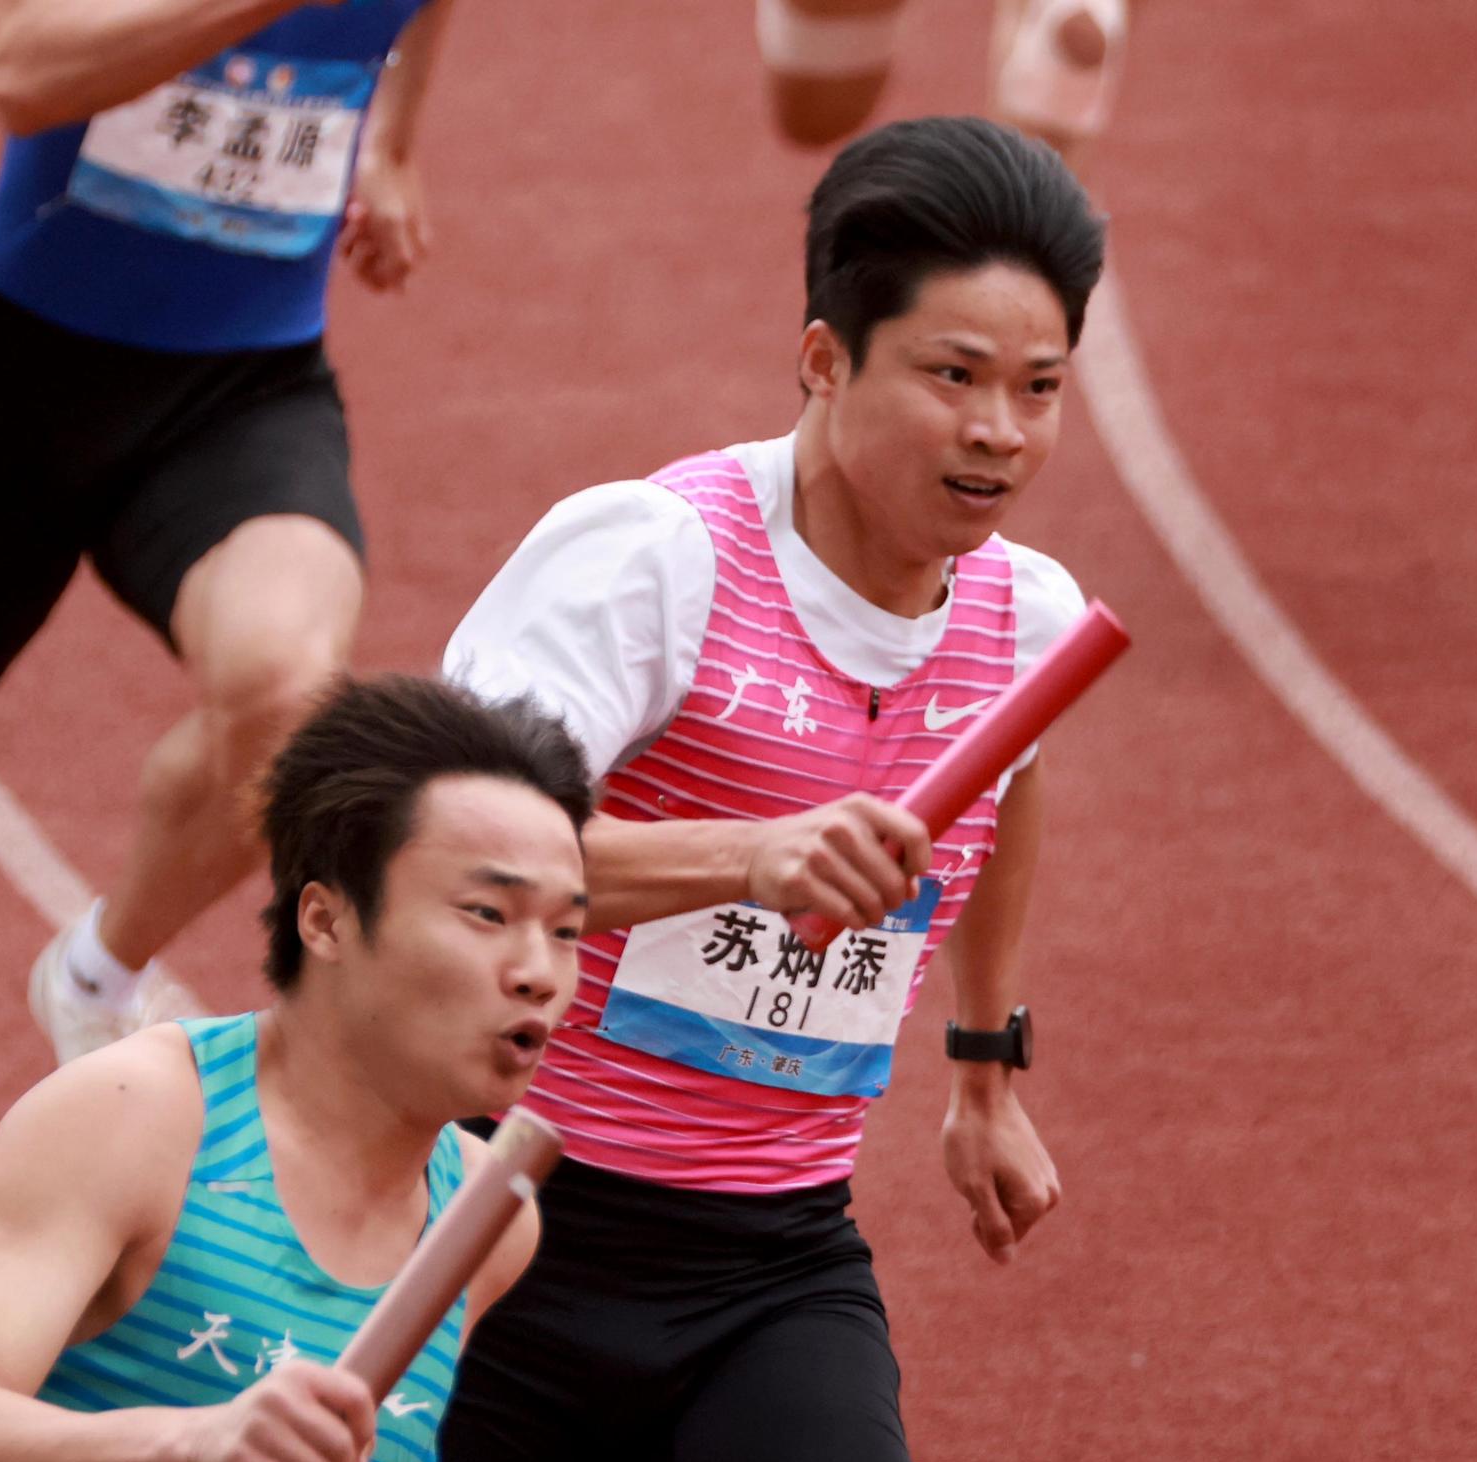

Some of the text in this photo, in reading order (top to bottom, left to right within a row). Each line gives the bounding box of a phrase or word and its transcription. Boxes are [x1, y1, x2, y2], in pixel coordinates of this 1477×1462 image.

[715, 663, 817, 736] 广东
[701, 909, 887, 995] 苏炳添
[745, 985, 813, 1031] 181
